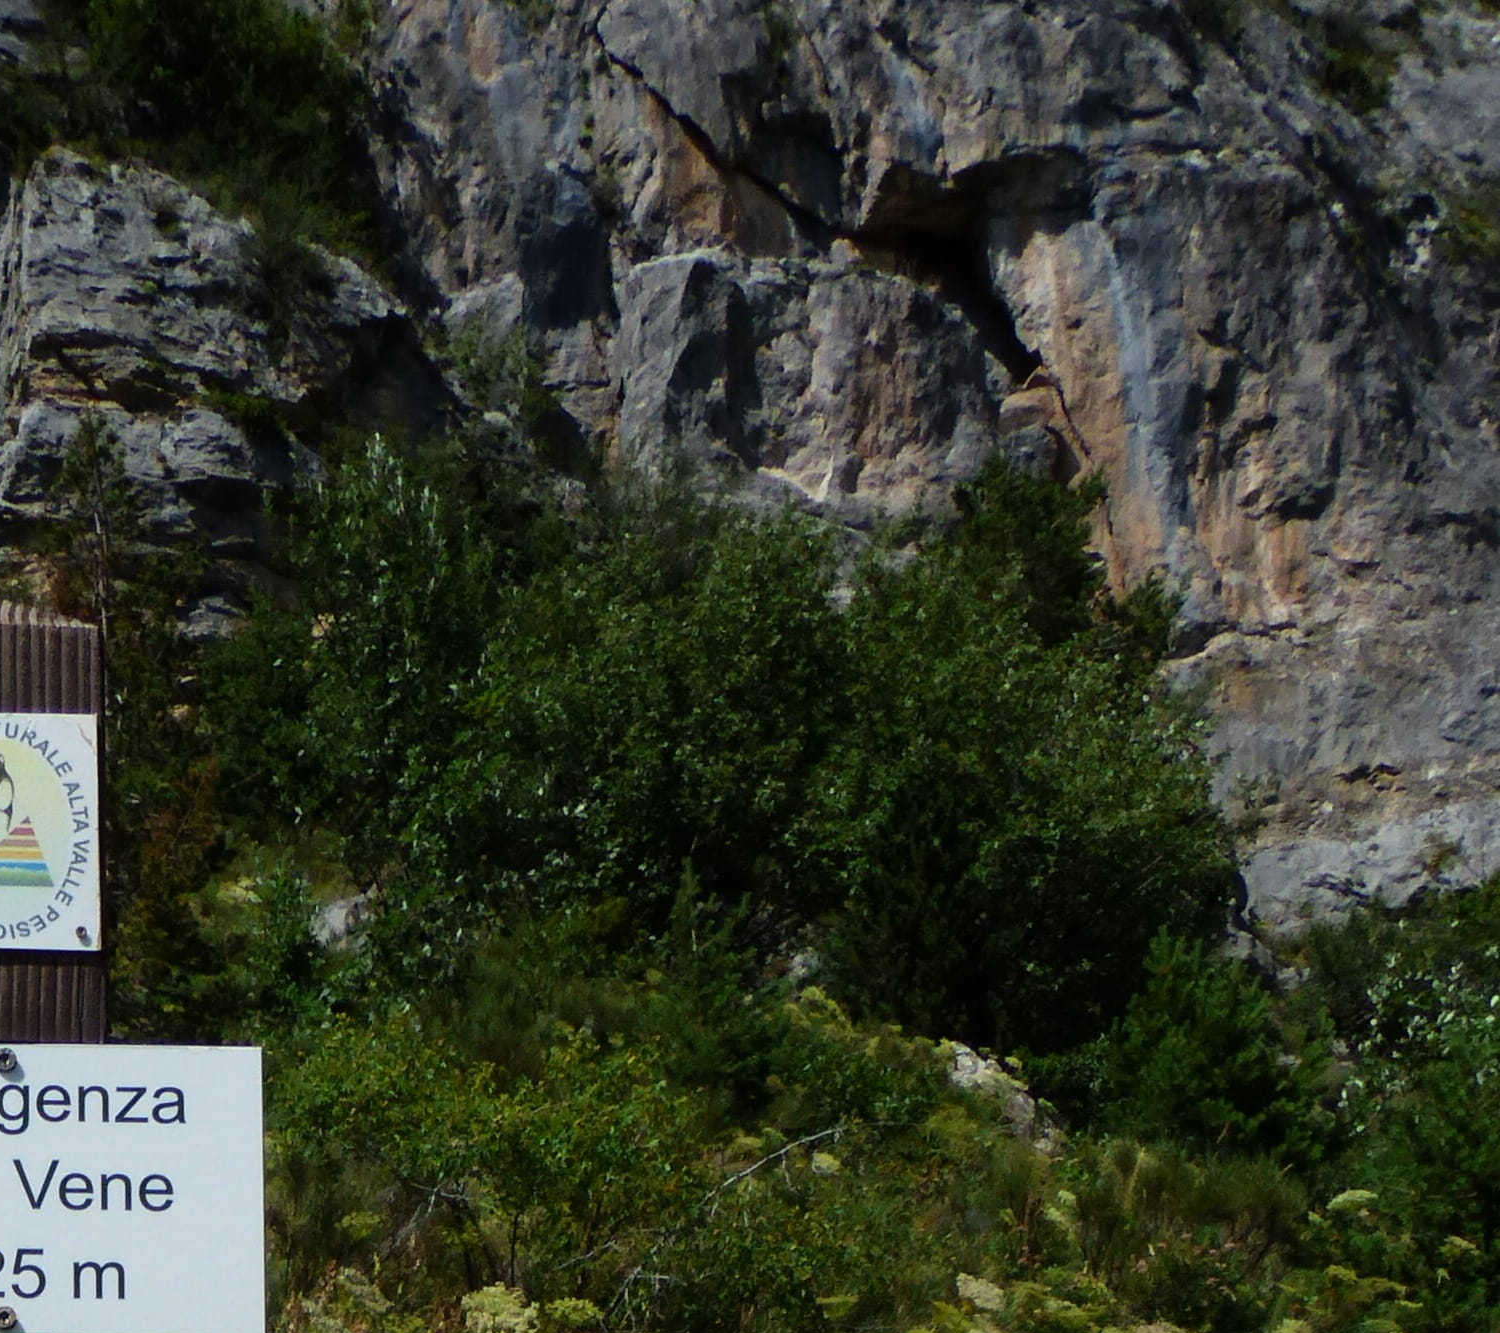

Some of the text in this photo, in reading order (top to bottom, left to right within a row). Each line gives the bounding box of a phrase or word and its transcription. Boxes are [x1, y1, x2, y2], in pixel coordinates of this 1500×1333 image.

[63, 781, 89, 833] ALTA
[55, 839, 90, 906] VALLE
[12, 1159, 174, 1212] Vene
[73, 1261, 125, 1300] m
